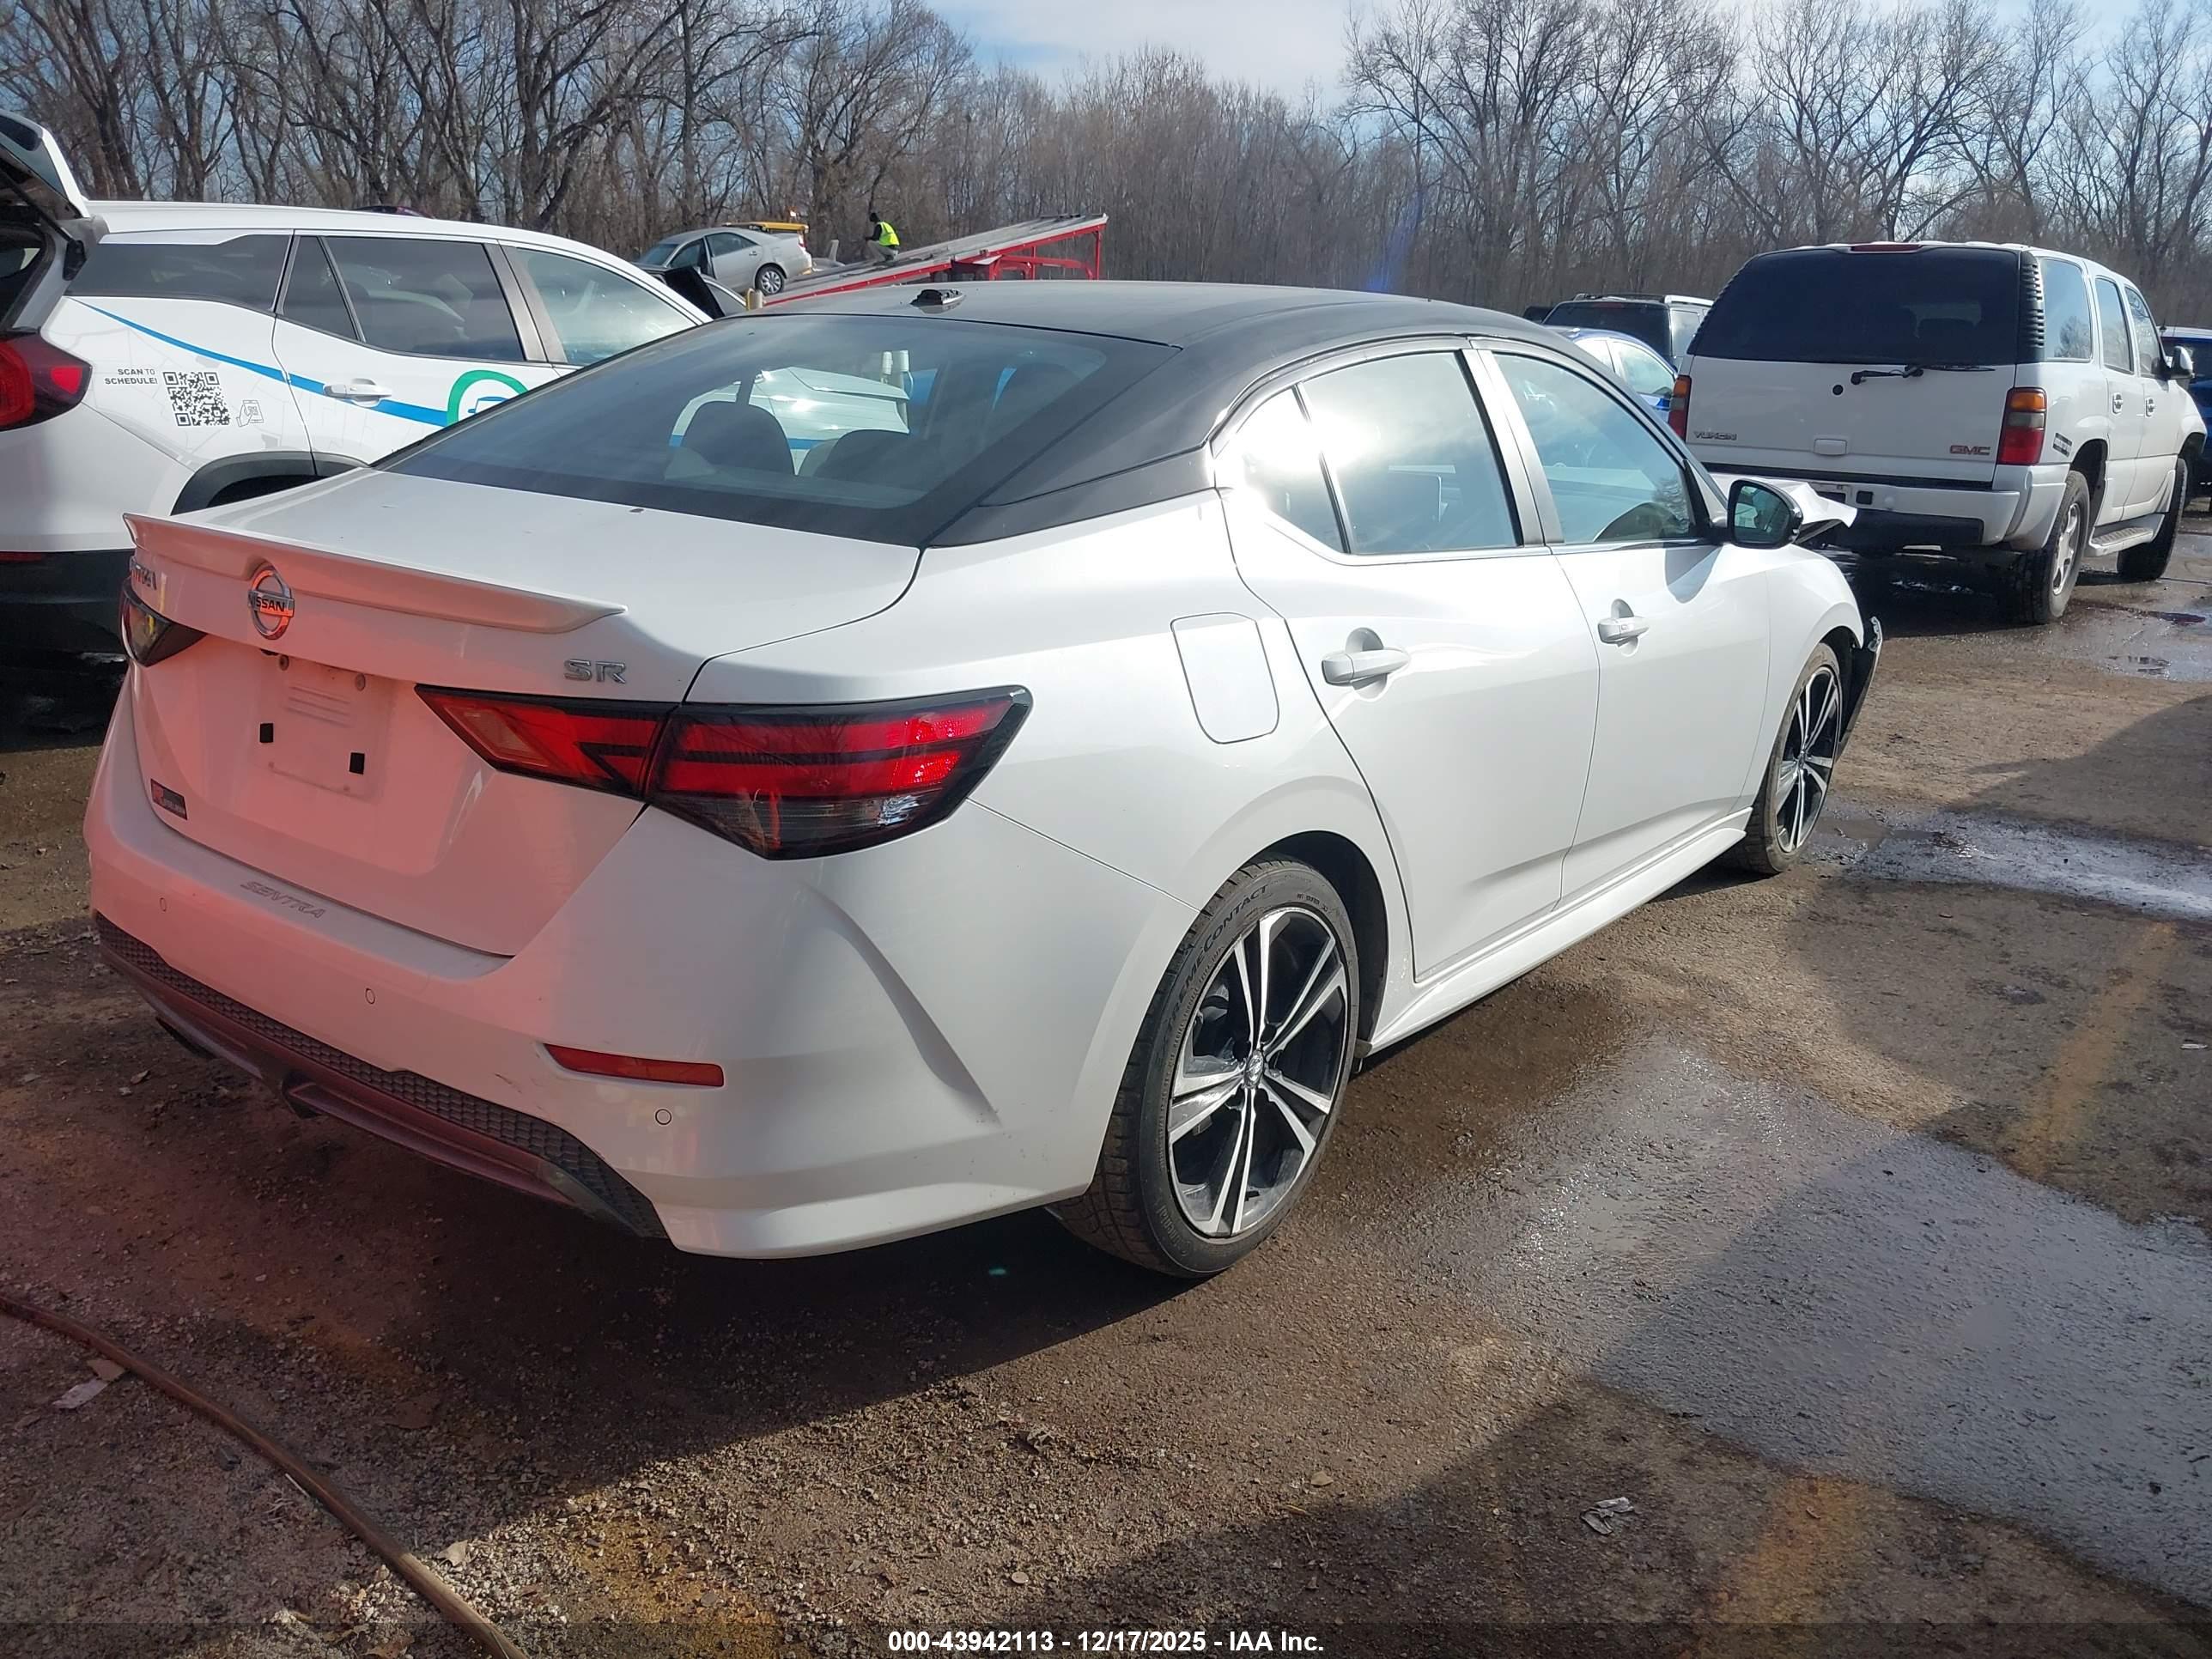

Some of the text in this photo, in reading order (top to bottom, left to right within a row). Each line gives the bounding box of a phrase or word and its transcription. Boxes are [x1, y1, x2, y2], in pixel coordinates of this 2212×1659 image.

[1693, 431, 1737, 441] YUKON
[1950, 445, 1990, 456] GMC
[563, 658, 626, 684] SR
[240, 881, 327, 919] SENTRA
